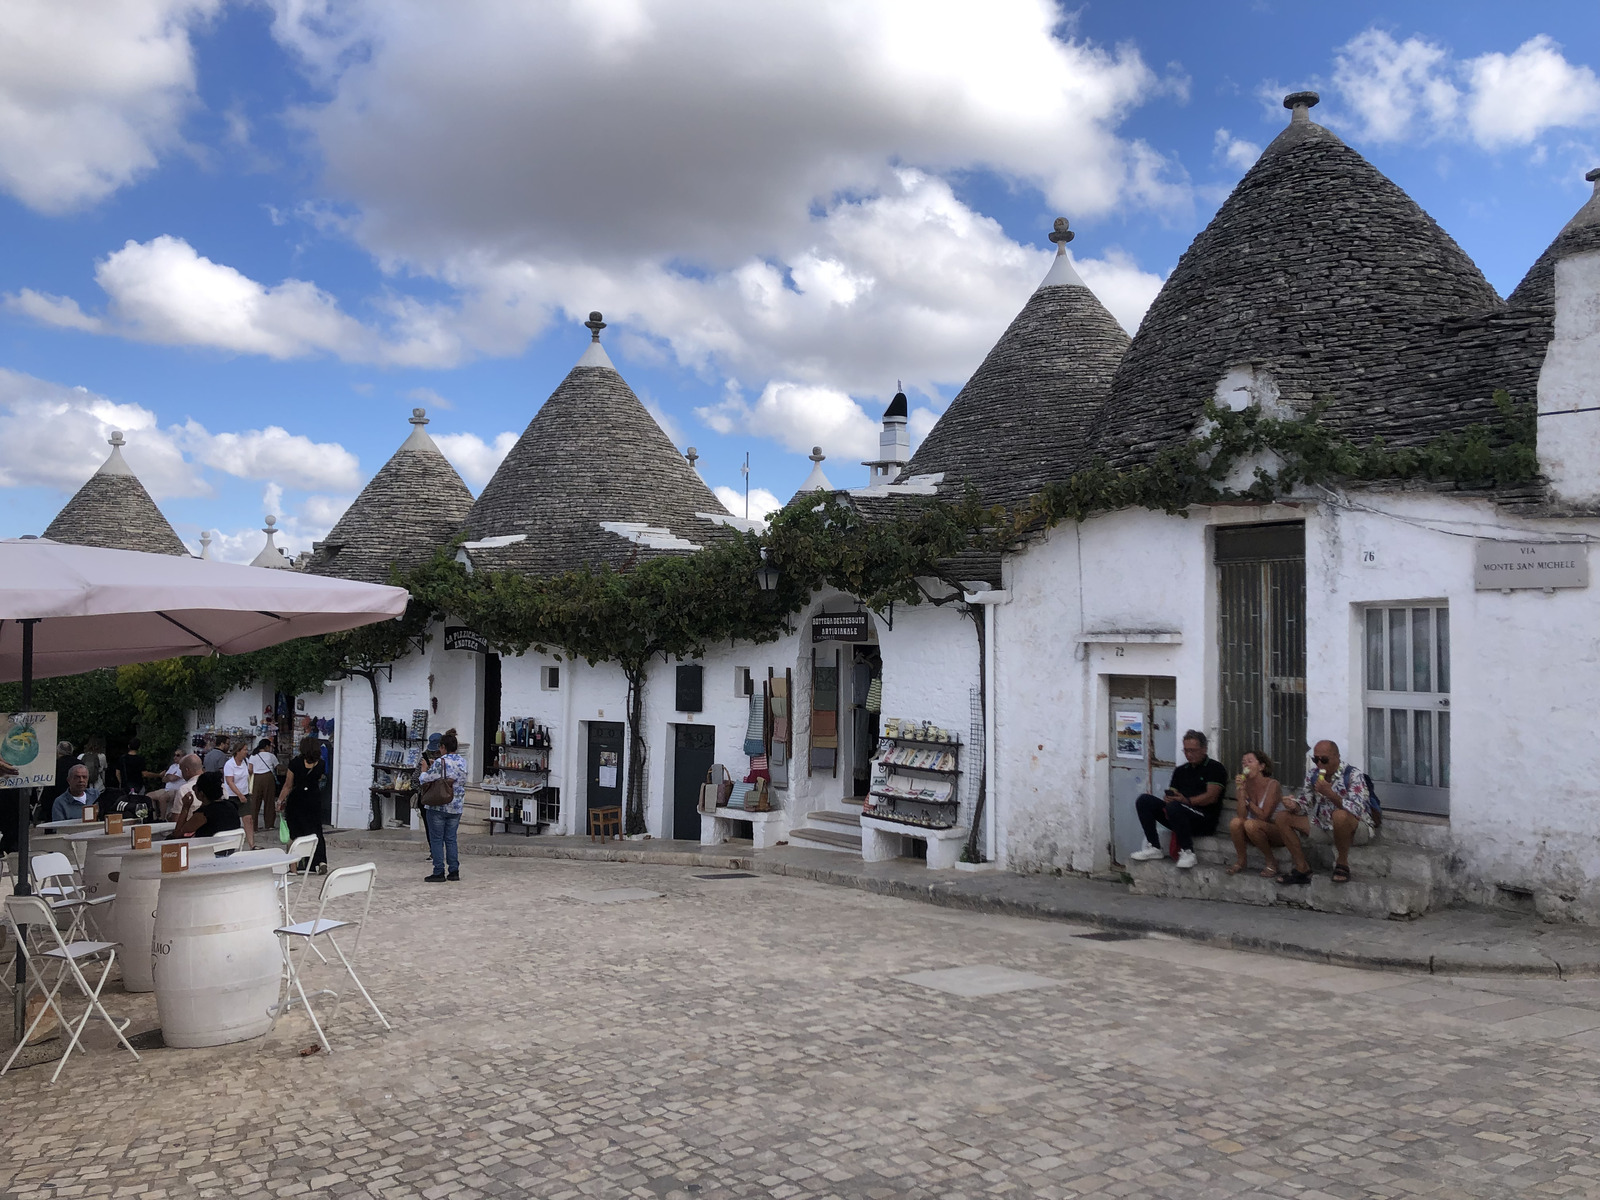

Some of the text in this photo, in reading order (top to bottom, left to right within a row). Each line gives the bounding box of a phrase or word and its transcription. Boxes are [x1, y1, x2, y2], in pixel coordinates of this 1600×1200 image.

[1363, 551, 1375, 562] 76
[1520, 547, 1536, 555] VIA
[1483, 561, 1575, 571] MONTE SAN MICHELE
[812, 617, 833, 626] BOTTEGA
[445, 634, 454, 645] LA
[454, 639, 479, 650] ENOTECA
[1115, 646, 1124, 657] 72
[8, 713, 46, 724] SPRITZ
[33, 773, 53, 783] BLU
